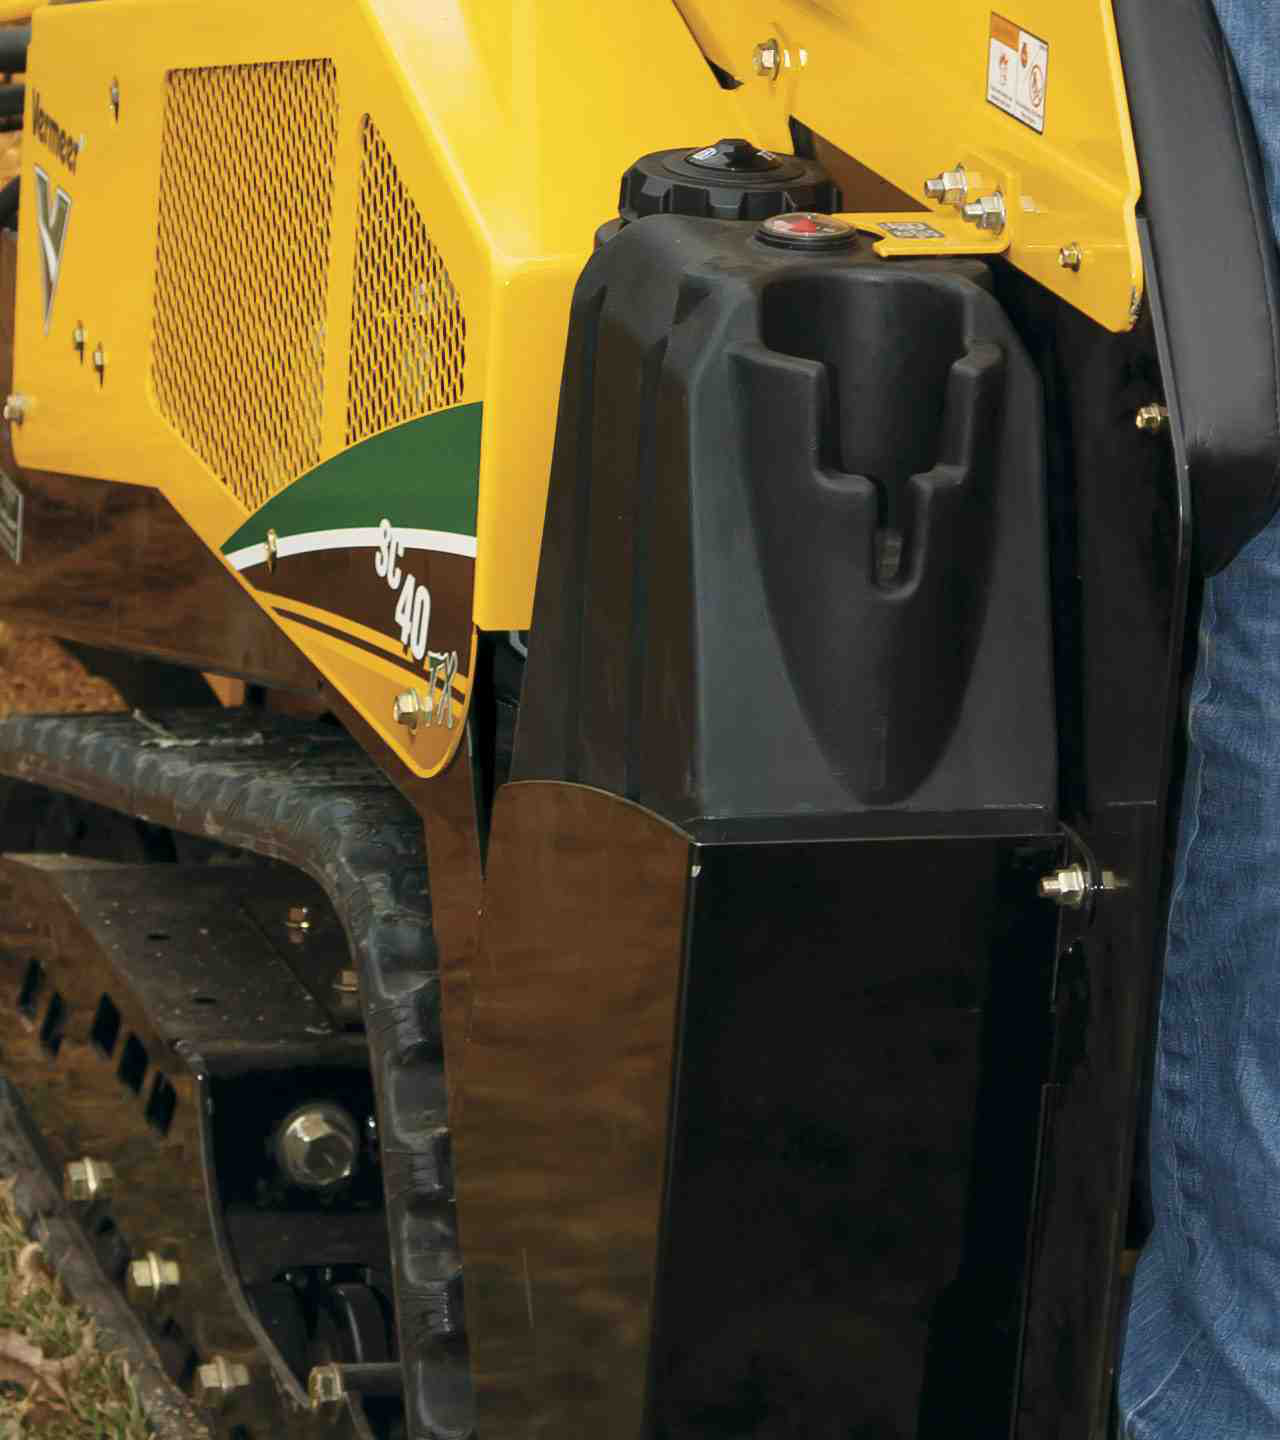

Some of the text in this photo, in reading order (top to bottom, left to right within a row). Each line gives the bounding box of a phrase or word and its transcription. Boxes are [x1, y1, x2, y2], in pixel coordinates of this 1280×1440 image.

[32, 88, 80, 176] Vermeer
[375, 518, 459, 729] SC 40 TX
